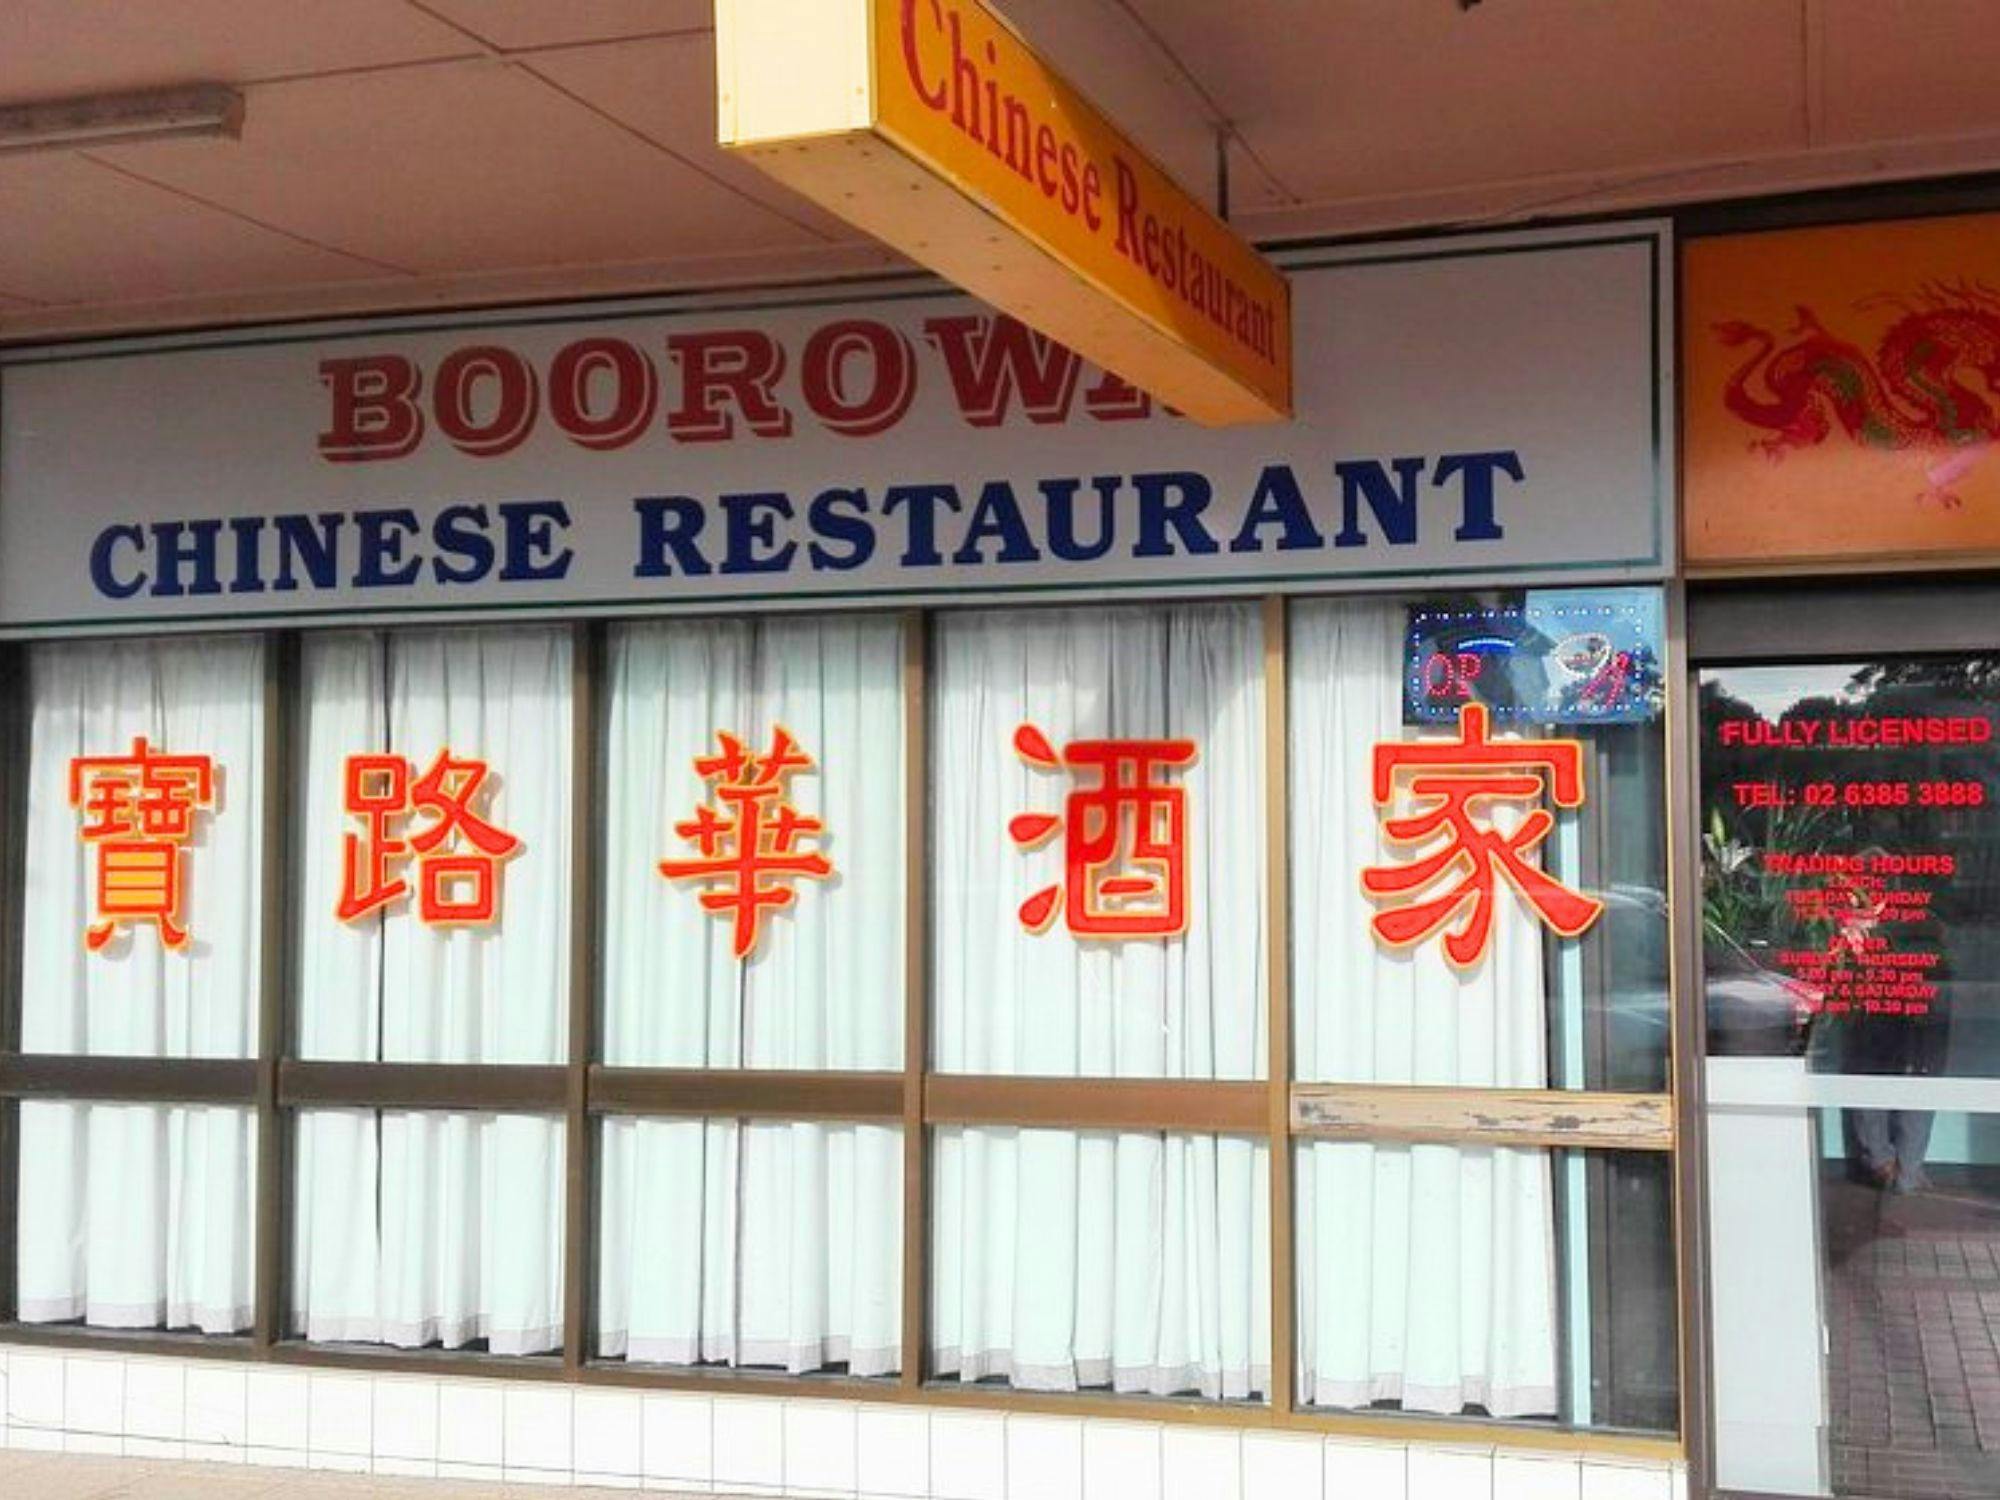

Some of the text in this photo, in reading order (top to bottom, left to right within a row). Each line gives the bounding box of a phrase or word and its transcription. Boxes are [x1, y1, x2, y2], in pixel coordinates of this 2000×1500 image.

[901, 0, 1276, 366] Chinese Restaurant
[90, 450, 1524, 599] CHINESE RESTAURANT
[1720, 716, 1992, 746] FULLY LICENSED
[1733, 783, 1796, 806] TEL:
[1803, 783, 1836, 806] 02
[1843, 782, 1909, 806] 6385
[1764, 854, 1956, 875] TRADING HOURS
